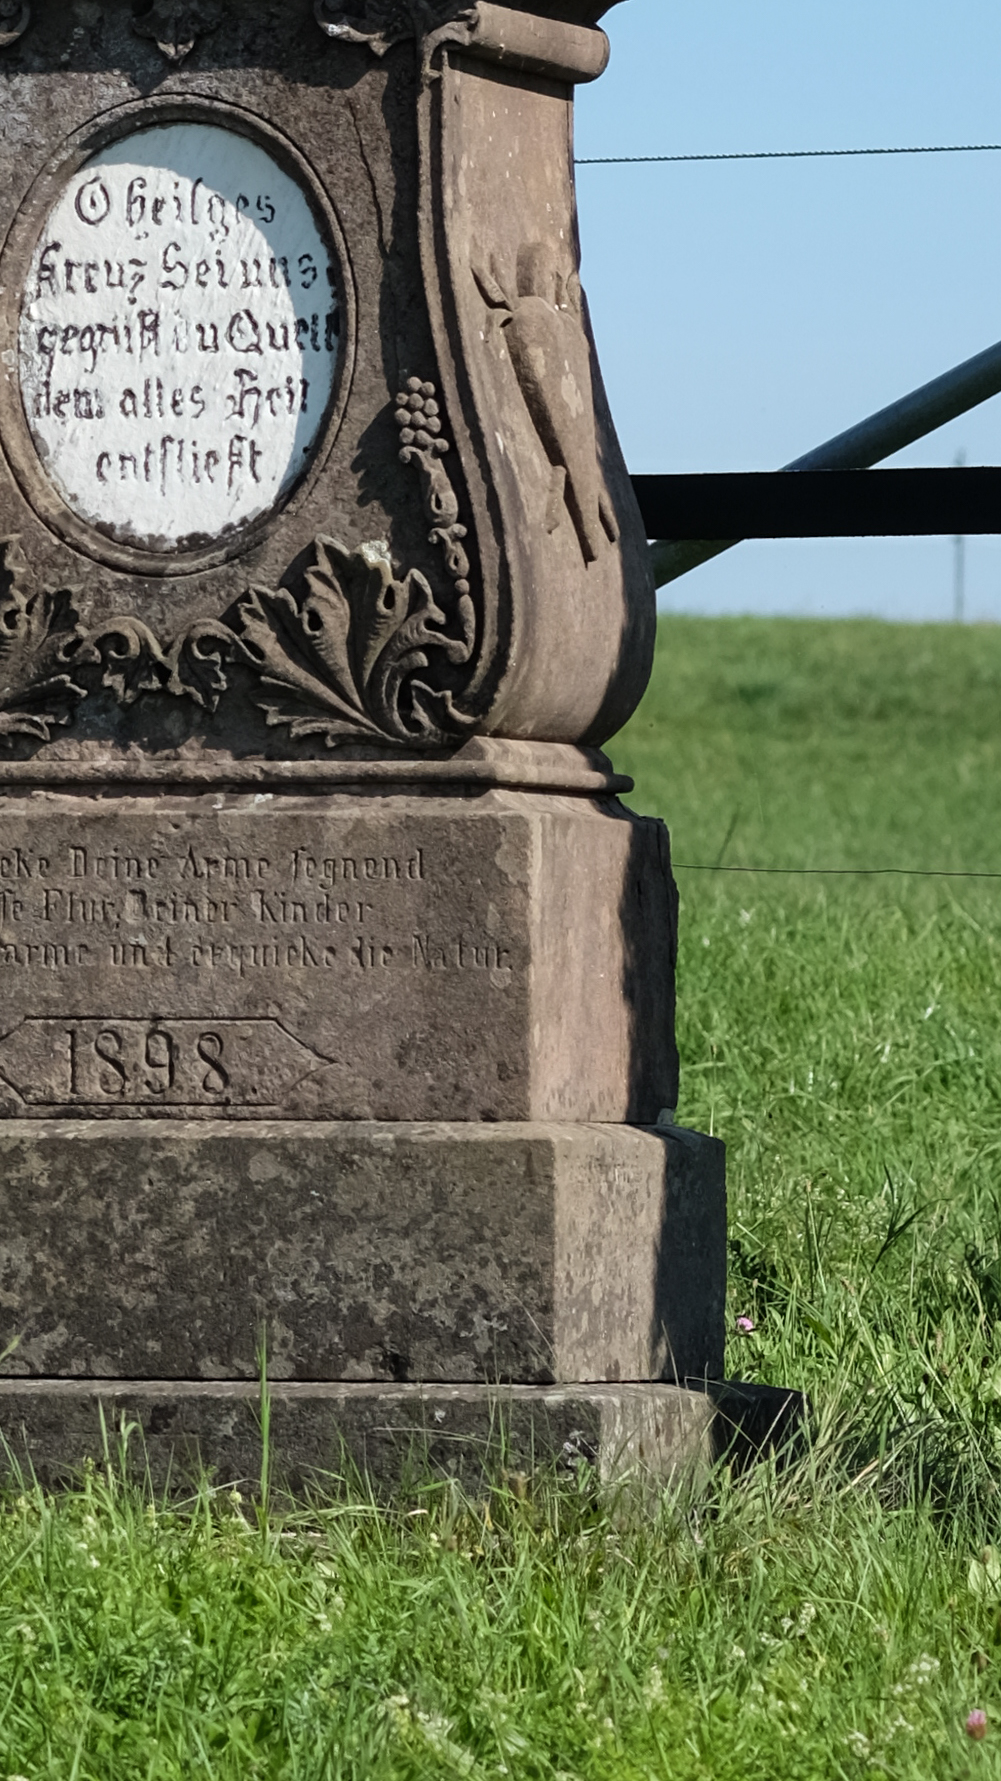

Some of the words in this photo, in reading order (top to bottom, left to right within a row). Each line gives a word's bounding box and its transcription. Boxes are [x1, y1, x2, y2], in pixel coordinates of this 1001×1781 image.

[74, 176, 111, 226] O
[36, 240, 148, 305] Kreuz
[172, 308, 220, 355] du
[118, 376, 206, 420] alles
[222, 368, 310, 430] Heil
[68, 844, 161, 880] Deine
[178, 843, 270, 880] Arme
[250, 888, 374, 923] Kinder
[109, 935, 175, 968] und
[190, 935, 337, 979] erquicke
[350, 935, 395, 971] die
